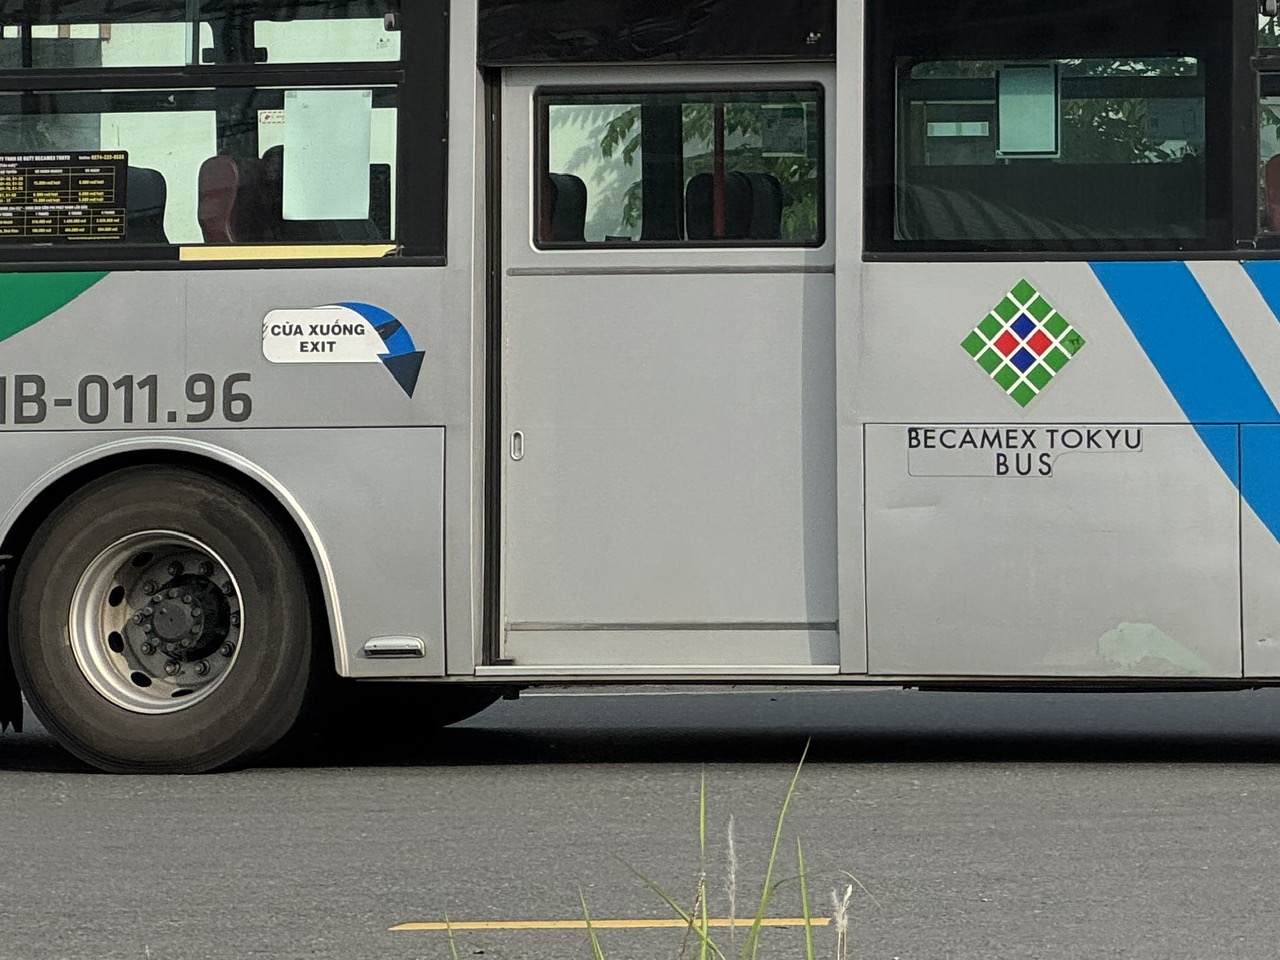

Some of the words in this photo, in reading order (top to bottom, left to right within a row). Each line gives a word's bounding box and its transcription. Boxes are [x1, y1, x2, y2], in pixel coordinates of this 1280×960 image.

[270, 321, 304, 336] CỬA
[308, 319, 365, 336] XUỐNG
[299, 341, 336, 352] EXIT
[908, 429, 1036, 449] BECAMEX
[1045, 429, 1142, 449] TOKYU
[996, 452, 1052, 476] BUS
